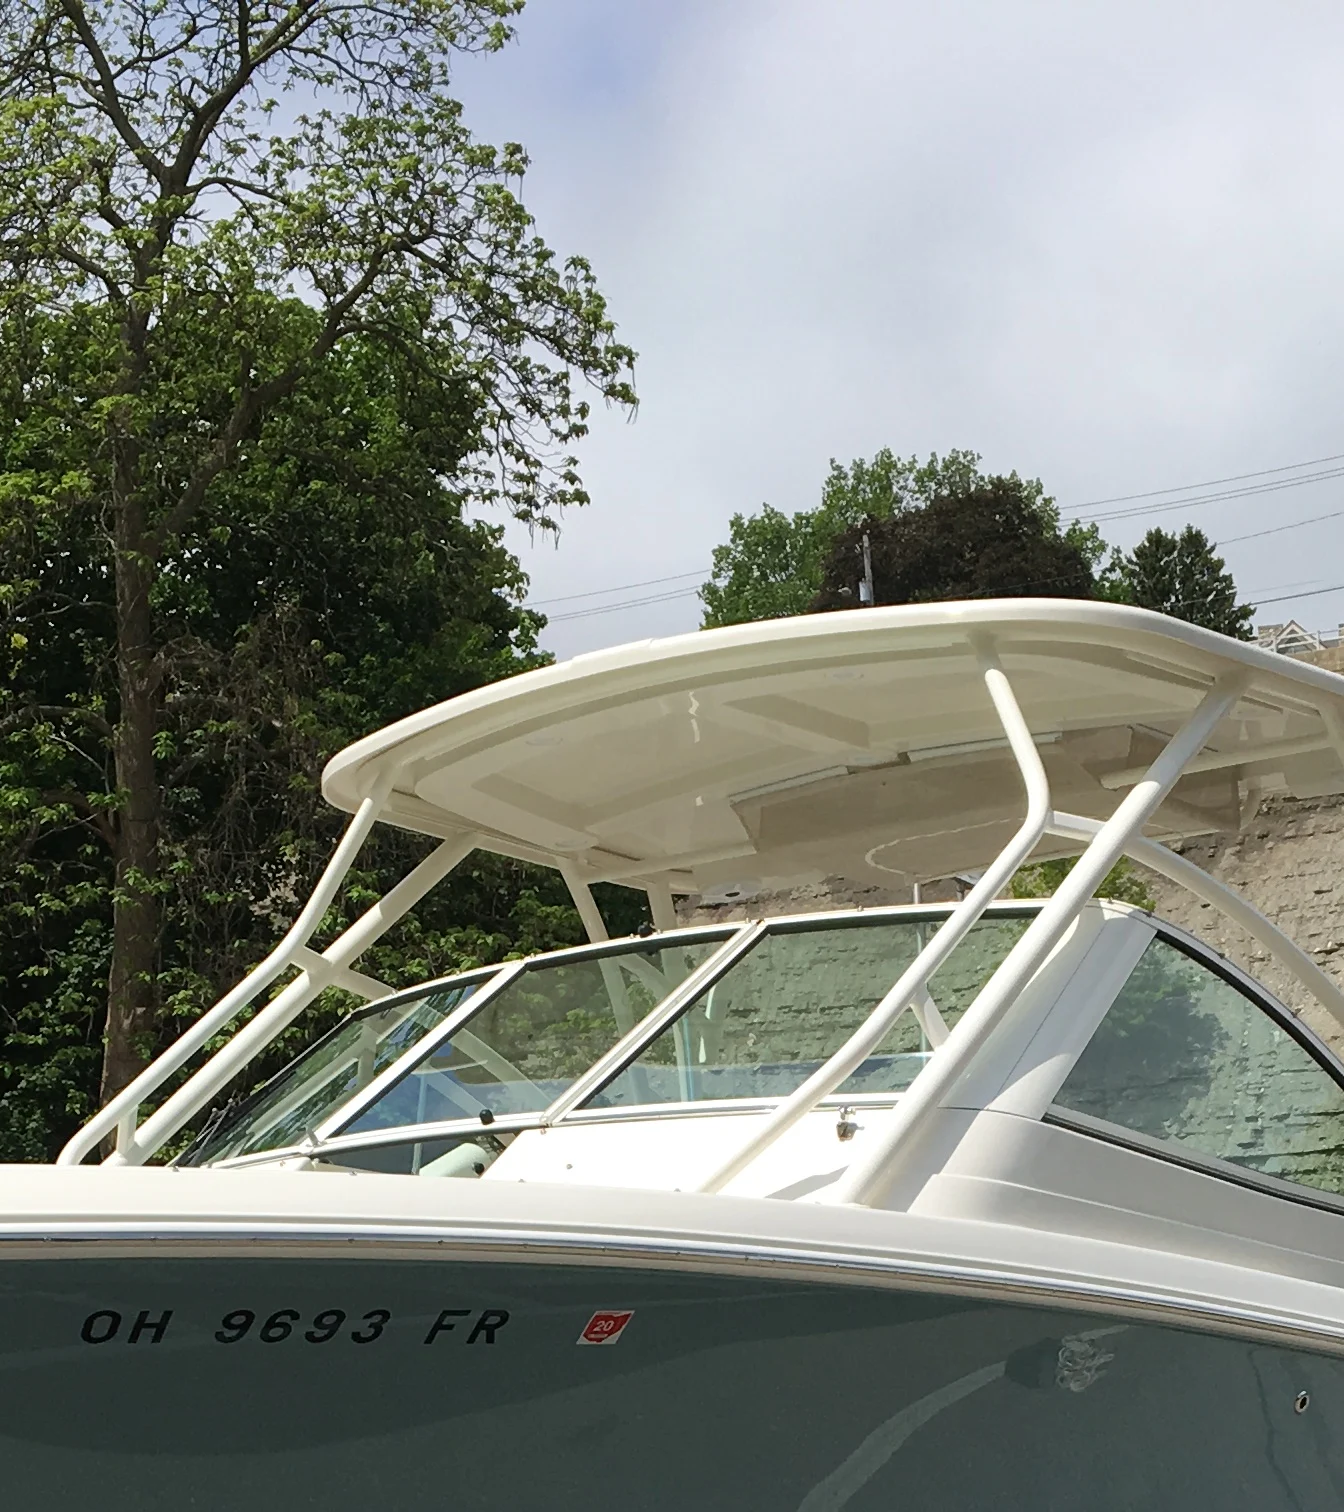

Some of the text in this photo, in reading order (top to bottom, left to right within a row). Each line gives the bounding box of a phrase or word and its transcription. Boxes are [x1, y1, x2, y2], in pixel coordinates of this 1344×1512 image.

[80, 1310, 509, 1344] OH 9693 FR
[593, 1320, 615, 1332] 20
